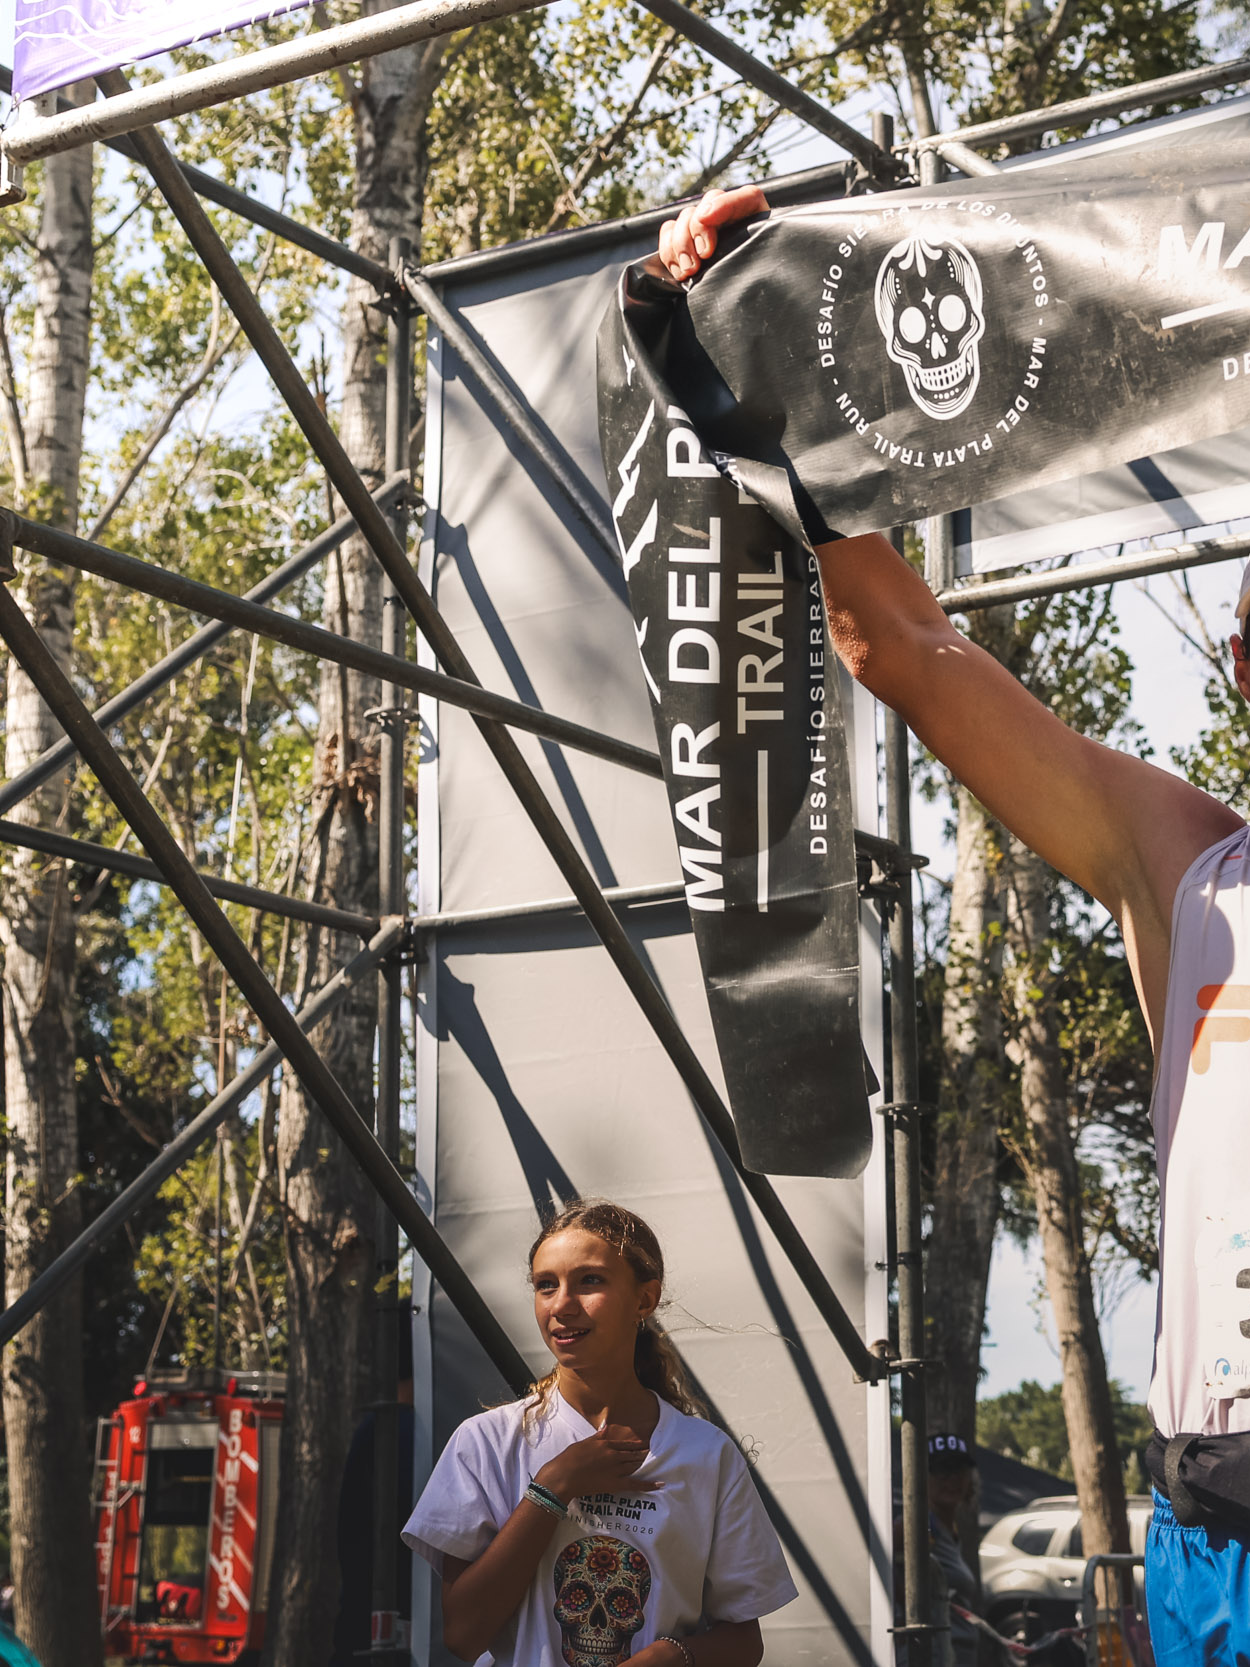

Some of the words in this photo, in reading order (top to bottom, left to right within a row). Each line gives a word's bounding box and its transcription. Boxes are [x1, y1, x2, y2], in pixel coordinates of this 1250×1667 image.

[957, 200, 996, 217] LOS
[1023, 337, 1047, 389] MAR
[835, 392, 870, 436] RUN
[996, 394, 1030, 433] DEL
[873, 432, 925, 468] TRAIL
[932, 433, 993, 468] PLATA
[668, 517, 721, 684] DEL
[737, 551, 784, 734] TRAIL
[670, 721, 725, 912] MAR
[579, 1502, 613, 1516] TRAIL
[615, 1507, 641, 1520] RUN
[594, 1493, 617, 1504] DEL
[619, 1498, 657, 1511] PLATA
[562, 1514, 622, 1530] FINISHER
[625, 1524, 654, 1535] 2026
